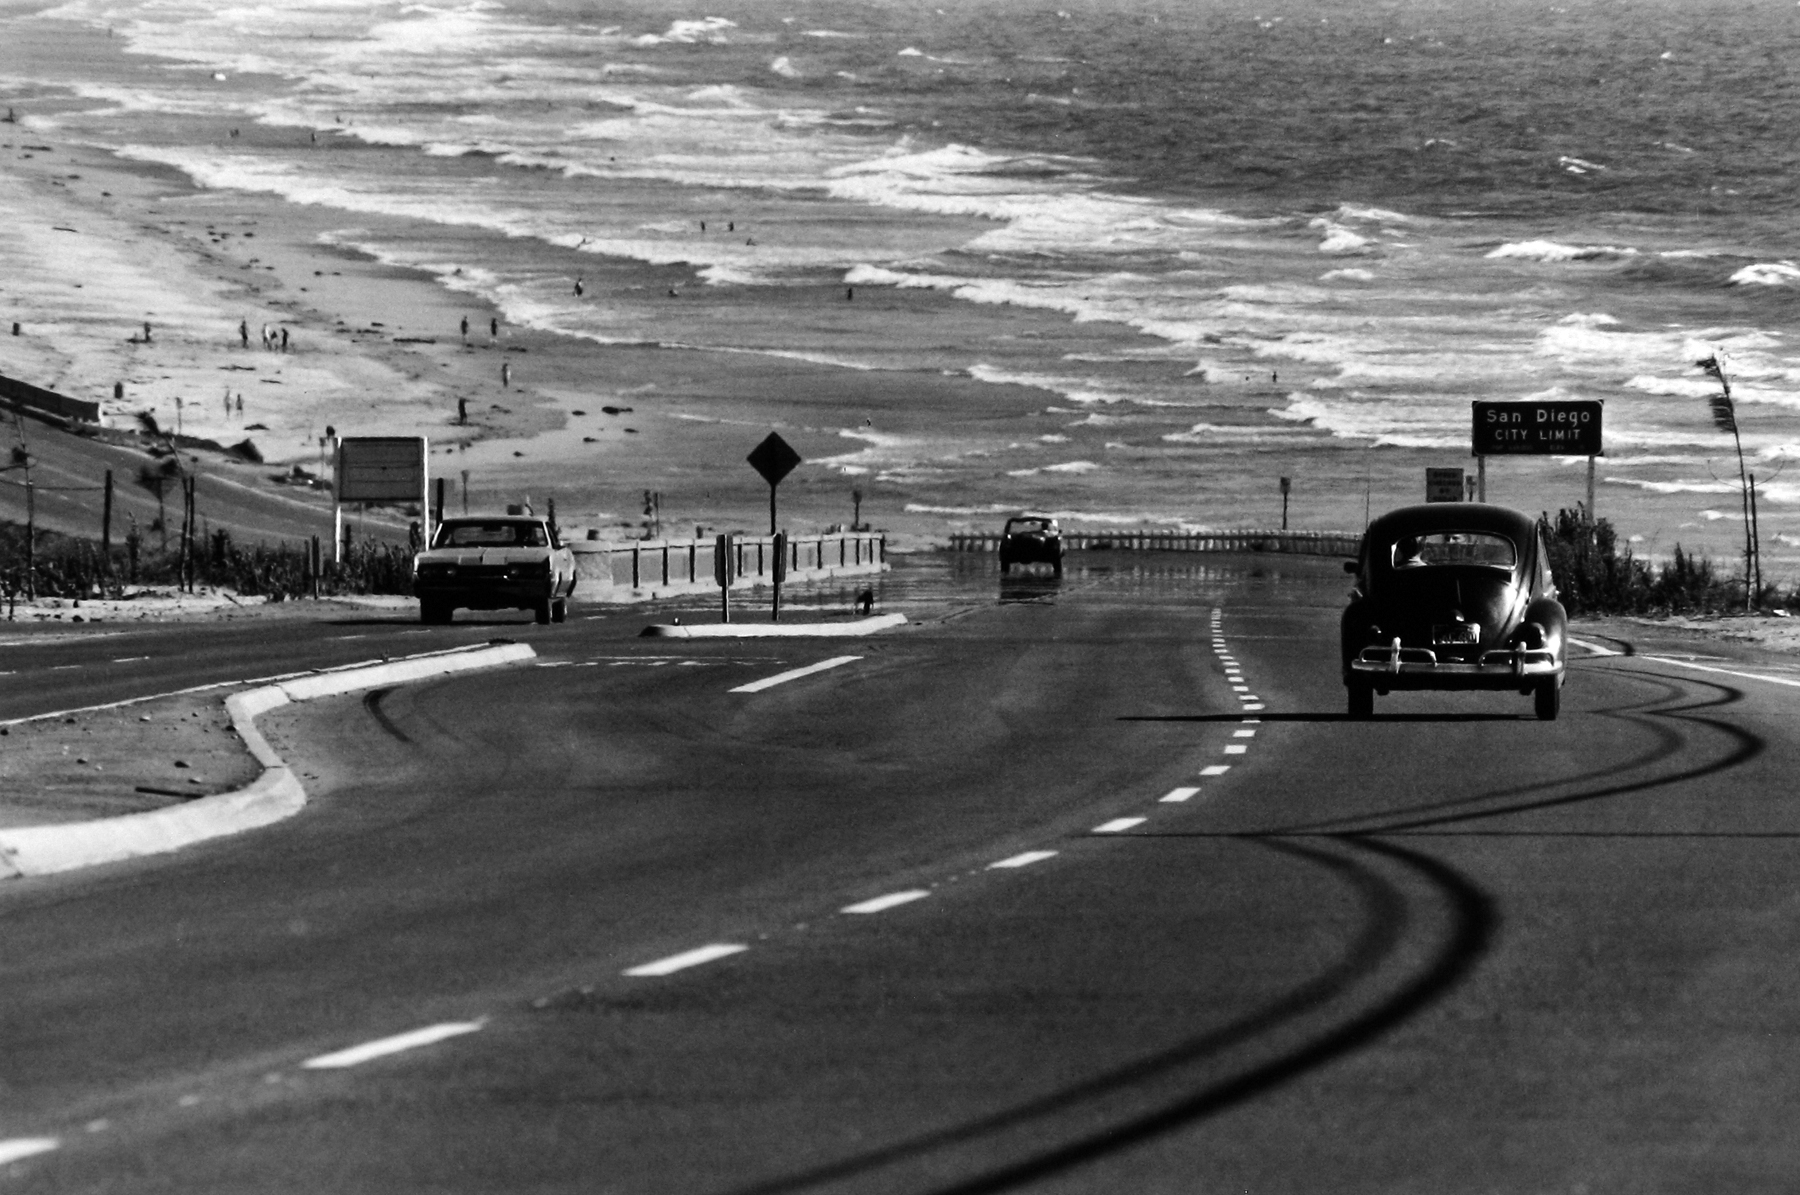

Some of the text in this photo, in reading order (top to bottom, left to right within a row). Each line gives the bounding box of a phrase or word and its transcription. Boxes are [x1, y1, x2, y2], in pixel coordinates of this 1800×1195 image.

[1487, 409, 1590, 427] San Diego
[1495, 429, 1581, 440] CITY LIMIT
